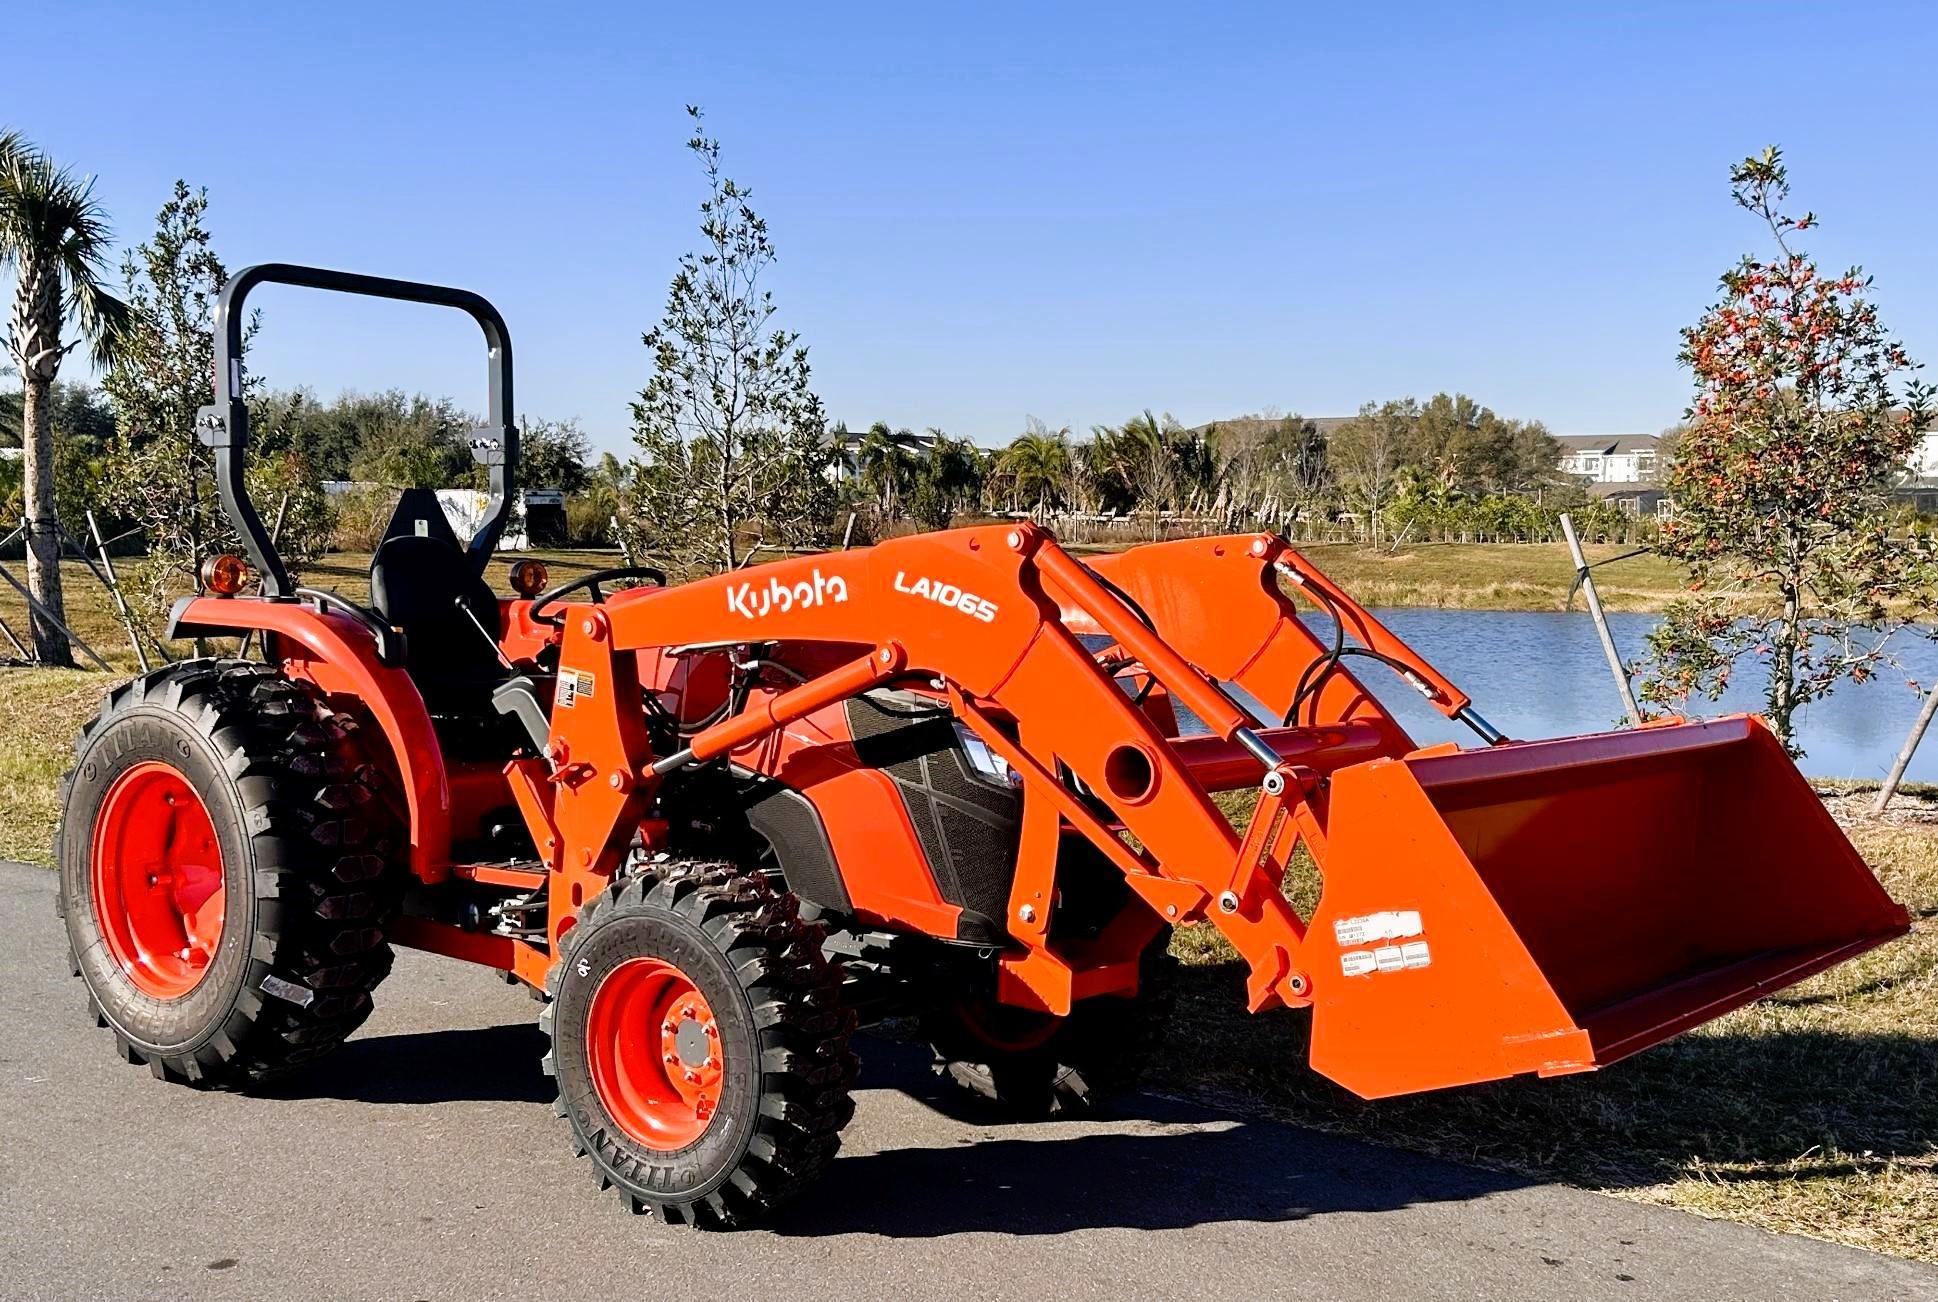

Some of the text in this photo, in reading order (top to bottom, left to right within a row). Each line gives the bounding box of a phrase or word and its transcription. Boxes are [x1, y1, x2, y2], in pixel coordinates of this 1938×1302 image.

[727, 568, 848, 619] Kubota
[893, 571, 998, 623] LA1065
[96, 719, 178, 769] TITAN
[590, 1128, 676, 1193] TITAN
